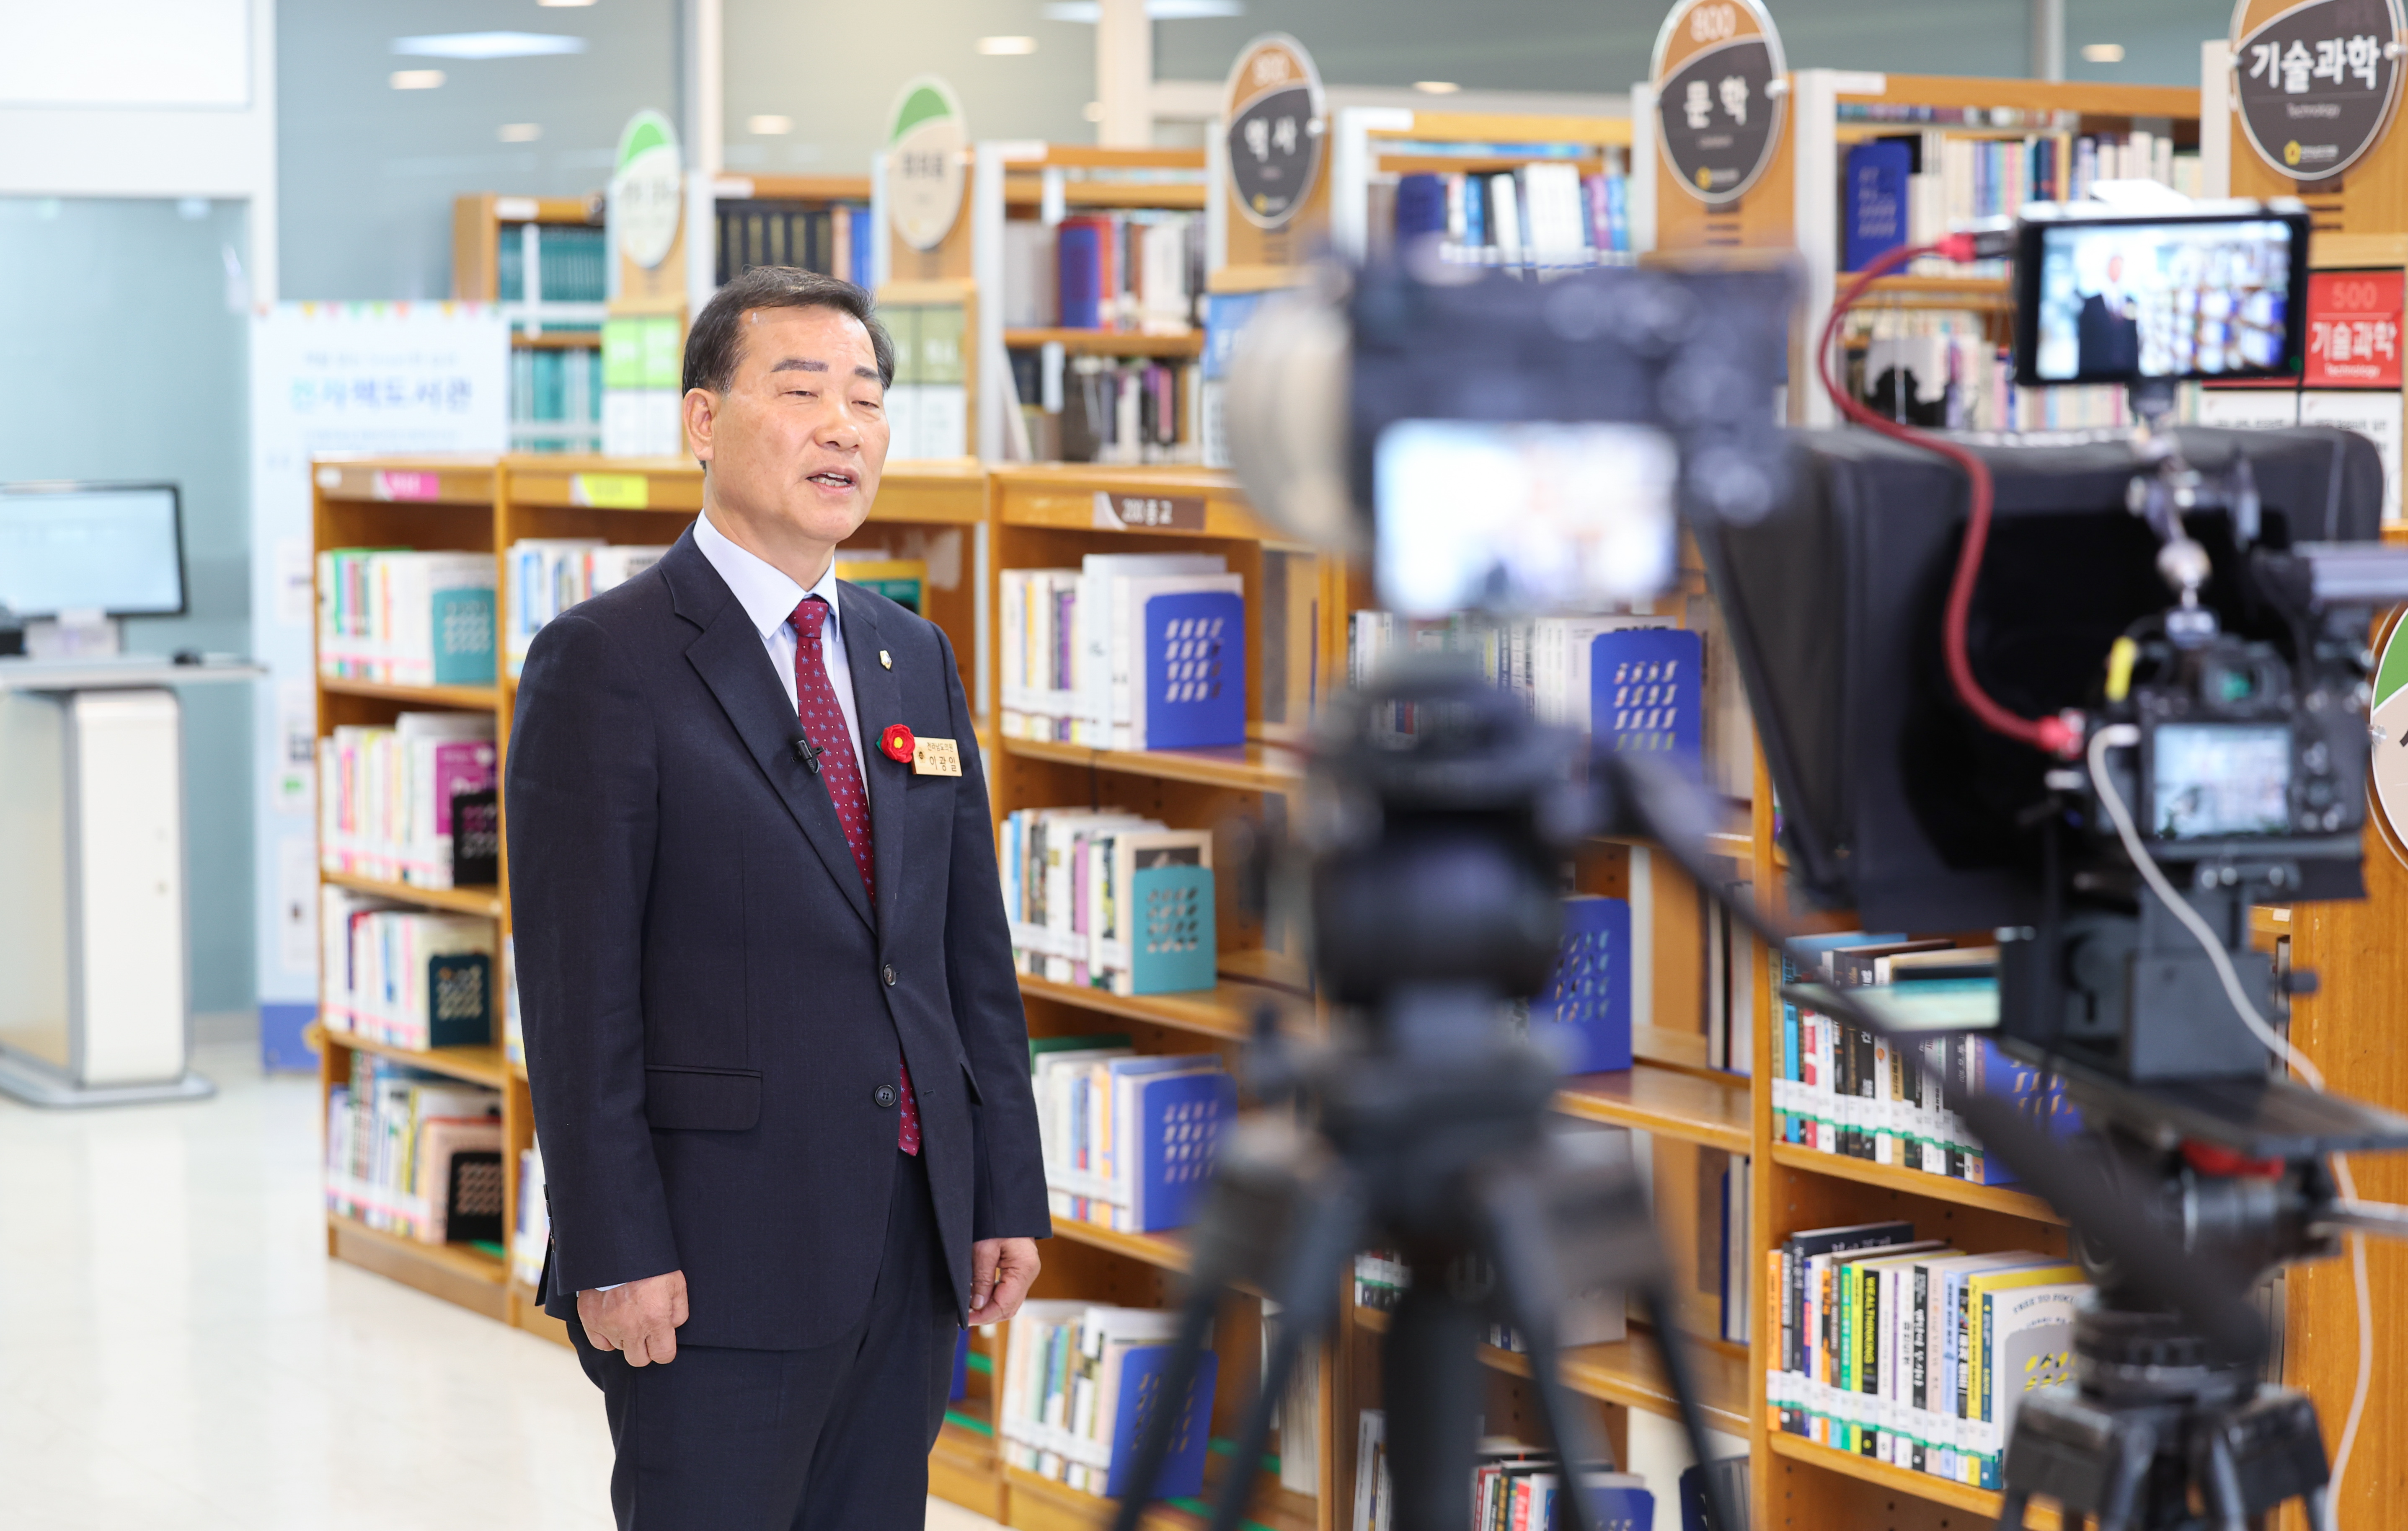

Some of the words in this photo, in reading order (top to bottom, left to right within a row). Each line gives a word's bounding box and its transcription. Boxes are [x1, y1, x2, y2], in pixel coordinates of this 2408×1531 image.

[1689, 4, 1736, 41] 800
[2249, 35, 2381, 94] 기술과학
[1683, 75, 1750, 129] 문학
[2332, 282, 2377, 309] 500
[2311, 321, 2397, 361] 기술과학
[929, 755, 957, 772] 이광일
[1864, 1276, 1876, 1365] WEALTHINKING
